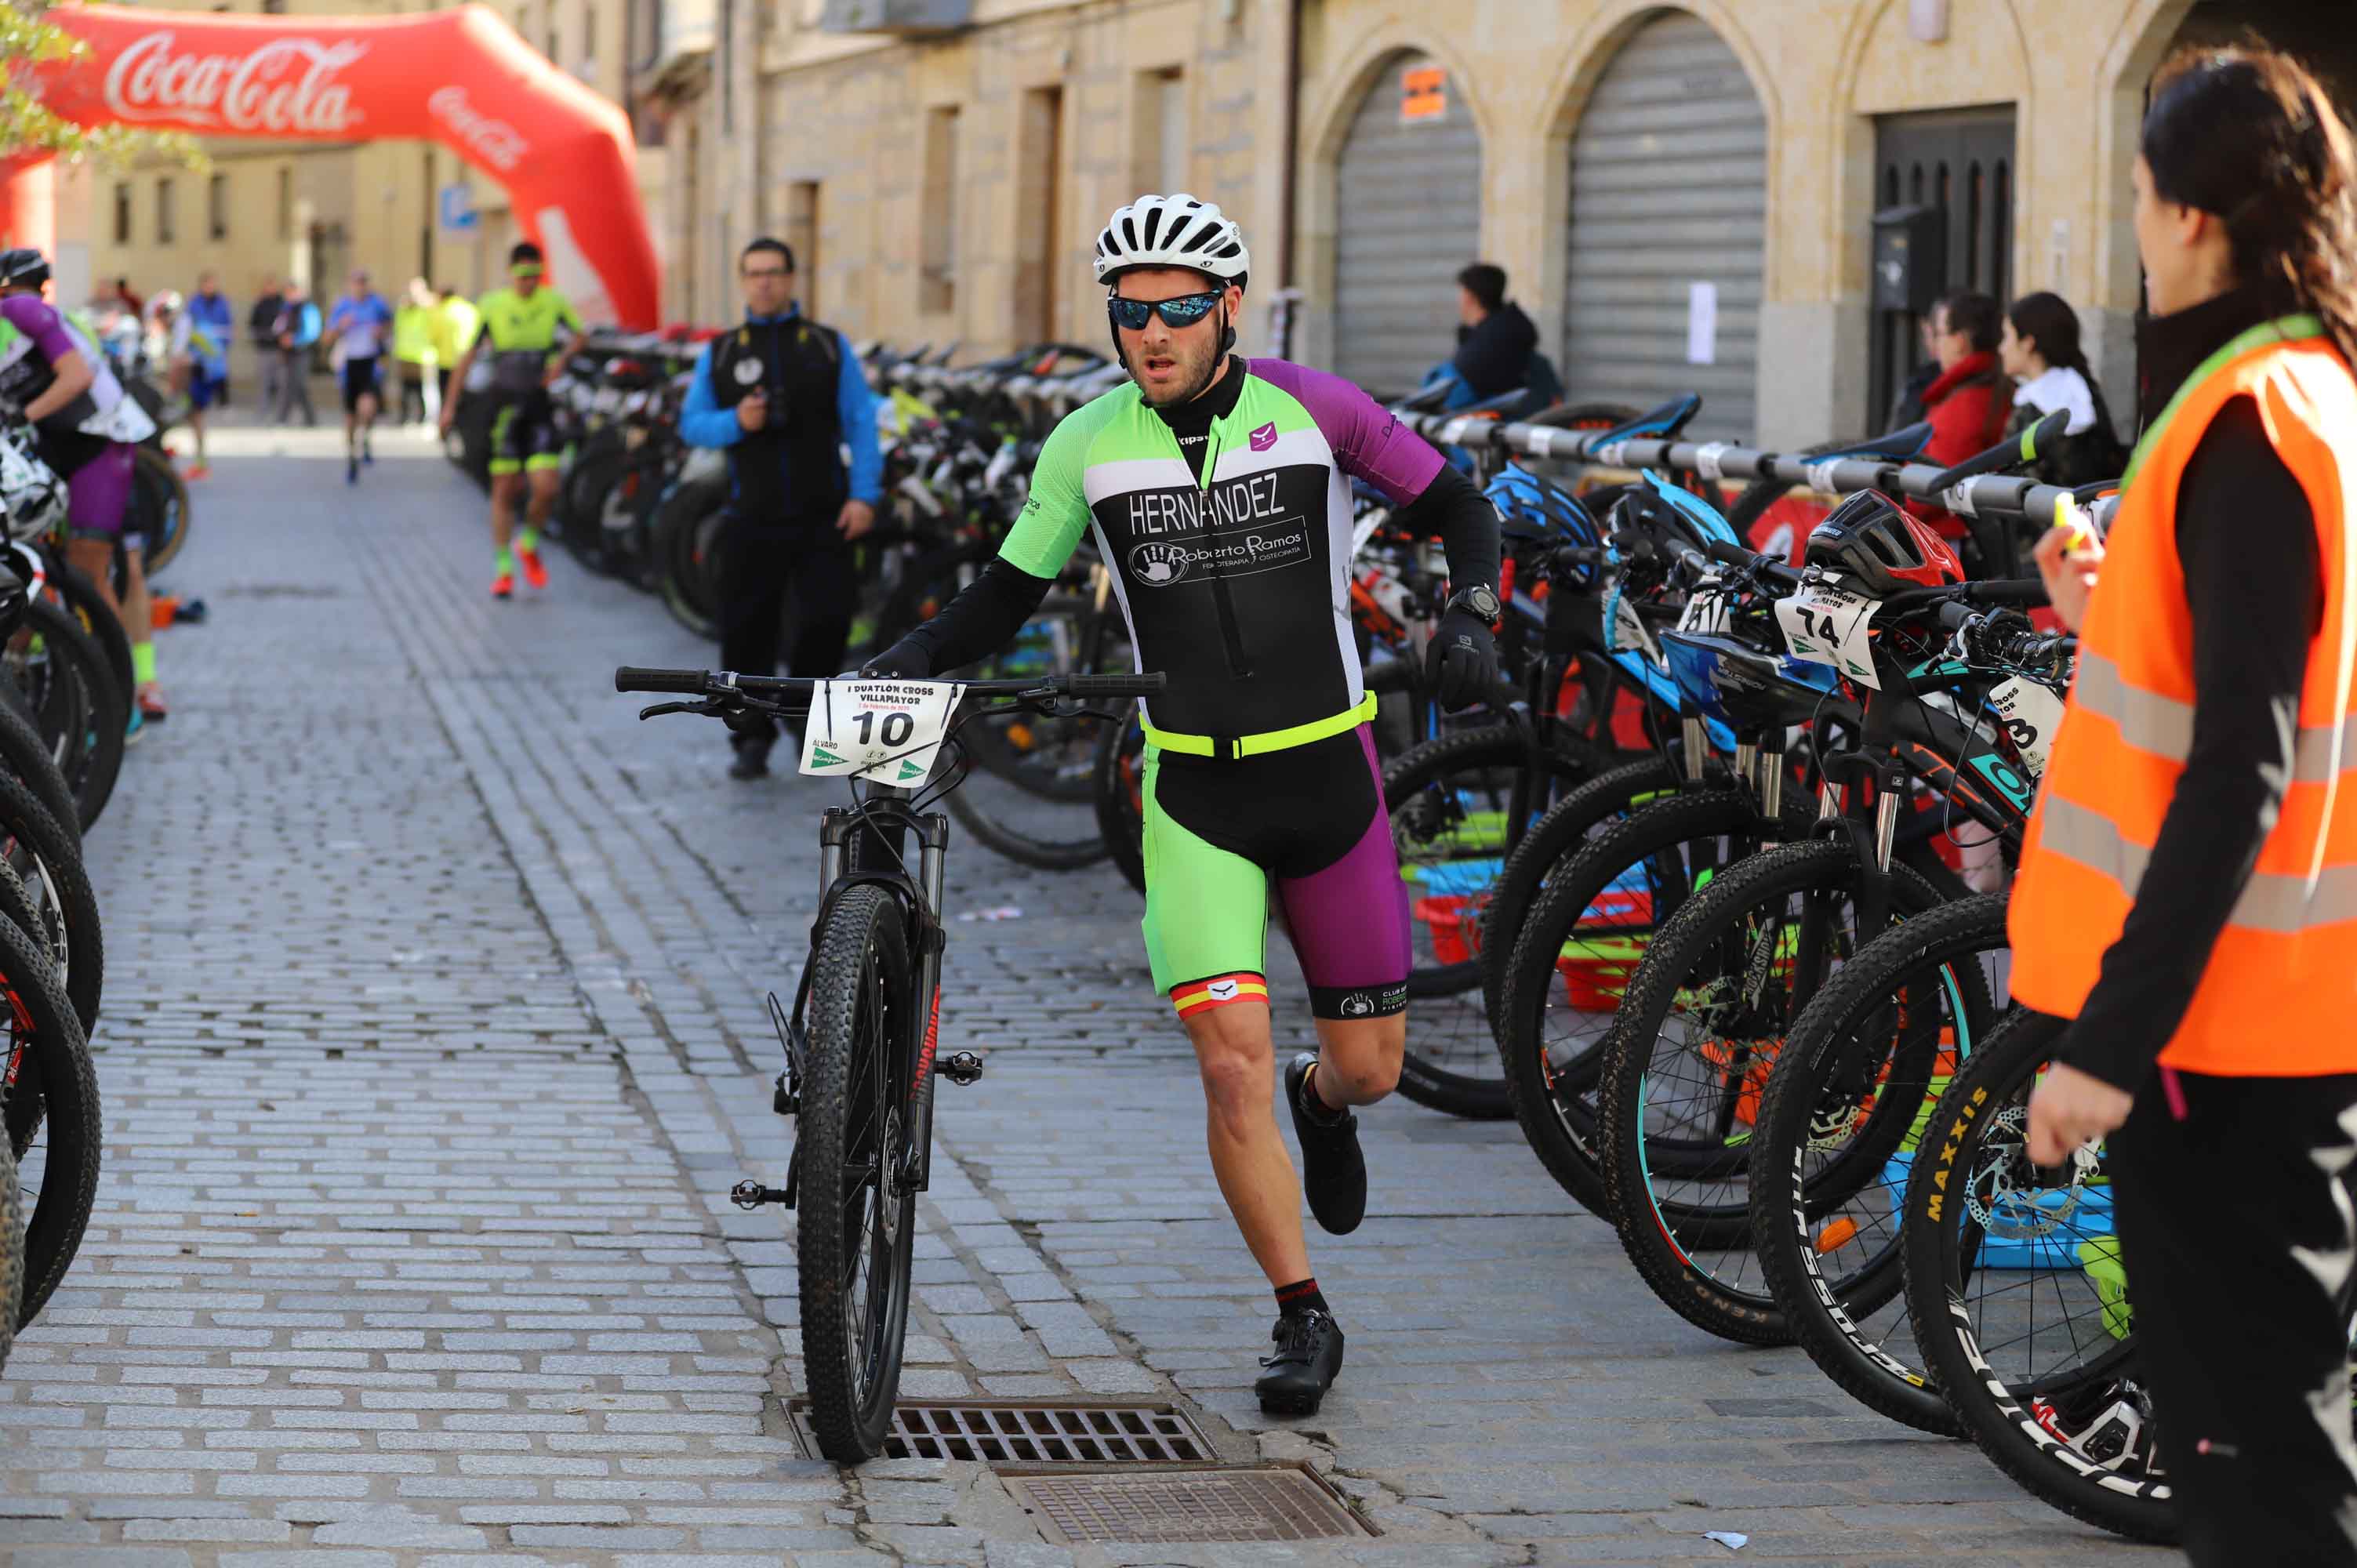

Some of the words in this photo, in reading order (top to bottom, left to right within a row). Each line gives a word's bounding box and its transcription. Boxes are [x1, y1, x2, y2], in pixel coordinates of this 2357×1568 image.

[104, 30, 370, 132] Coca-Cola
[1129, 472, 1286, 535] HERNANDEZ
[1171, 545, 1246, 565] Roberto
[1246, 534, 1302, 554] Ramos
[1796, 605, 1840, 649] 74
[854, 684, 900, 694] DUATLÓN
[902, 686, 934, 696] CROSS
[860, 694, 921, 705] VILLAMAYOR
[852, 710, 915, 747] 10
[1927, 1085, 1988, 1223] MAXXIS
